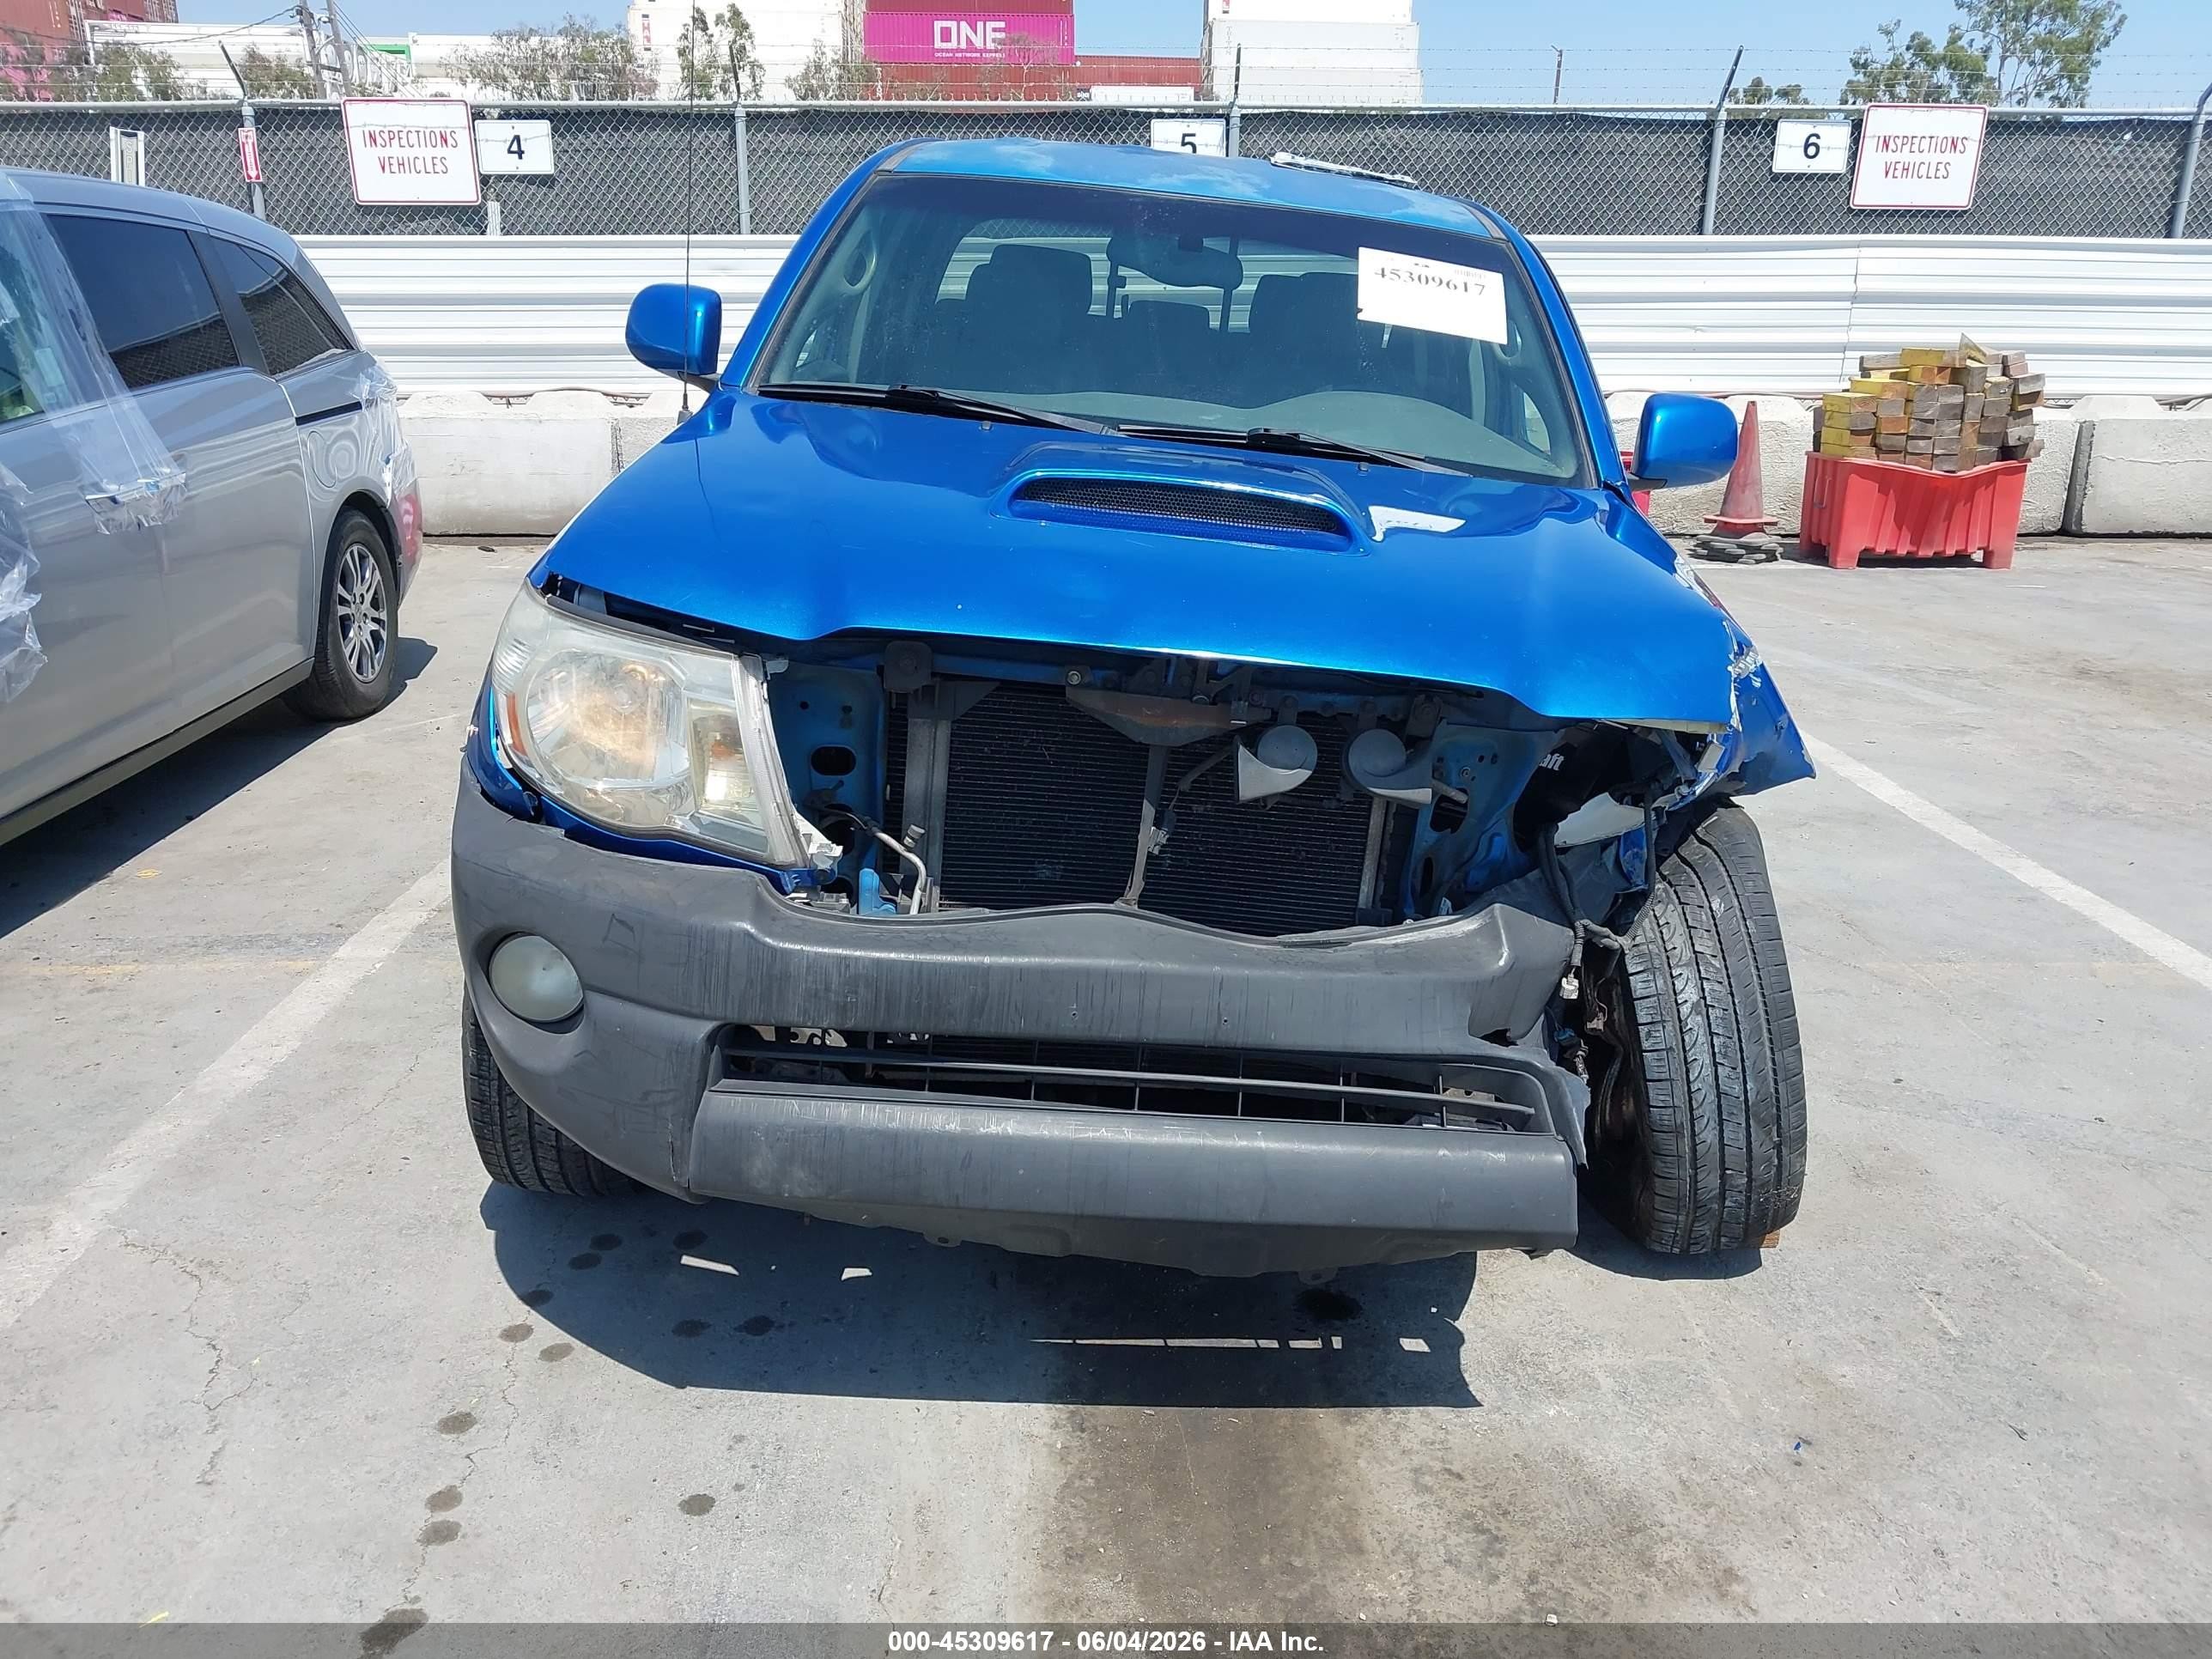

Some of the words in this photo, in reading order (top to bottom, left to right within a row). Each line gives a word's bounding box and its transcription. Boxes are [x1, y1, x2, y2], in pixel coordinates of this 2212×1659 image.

[933, 20, 1006, 50] ONE
[362, 130, 459, 149] INSPECTIONS
[507, 135, 525, 160] 4
[1181, 133, 1197, 154] 5
[1803, 133, 1821, 160] 6
[1875, 135, 1968, 155] INSPECTIONS
[378, 156, 448, 174] VEHICLES
[1885, 161, 1951, 179] VEHICLES
[1374, 267, 1486, 295] 45309617
